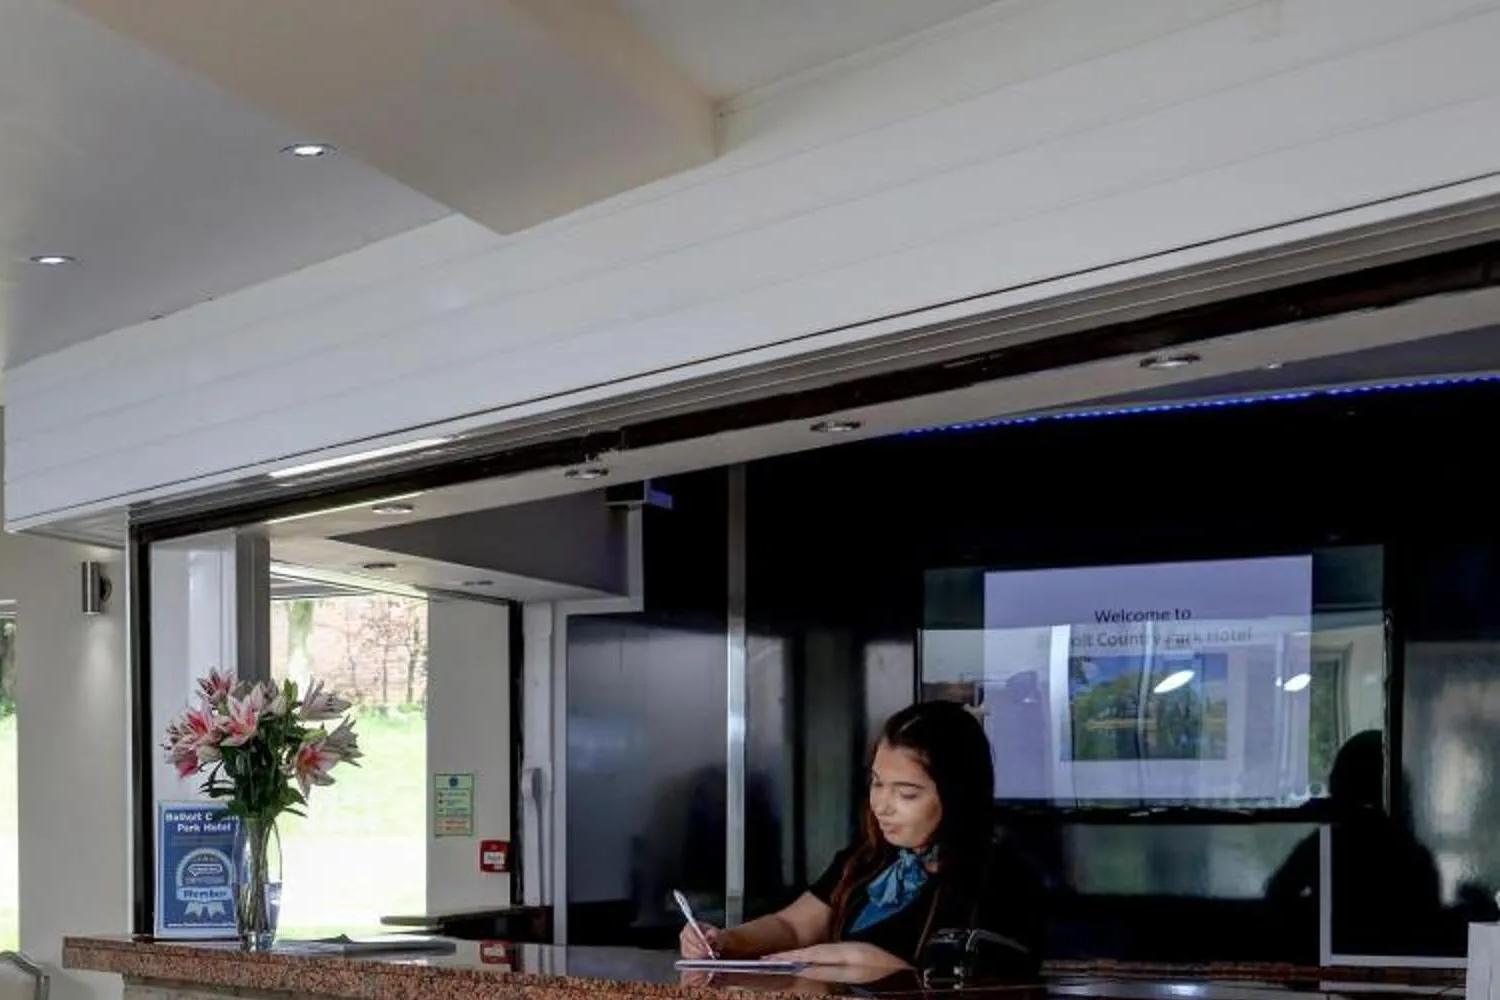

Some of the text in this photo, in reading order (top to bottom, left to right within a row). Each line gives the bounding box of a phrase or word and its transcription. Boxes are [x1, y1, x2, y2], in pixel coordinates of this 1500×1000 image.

[1094, 607, 1192, 624] Welcome to
[1097, 631, 1161, 648] County
